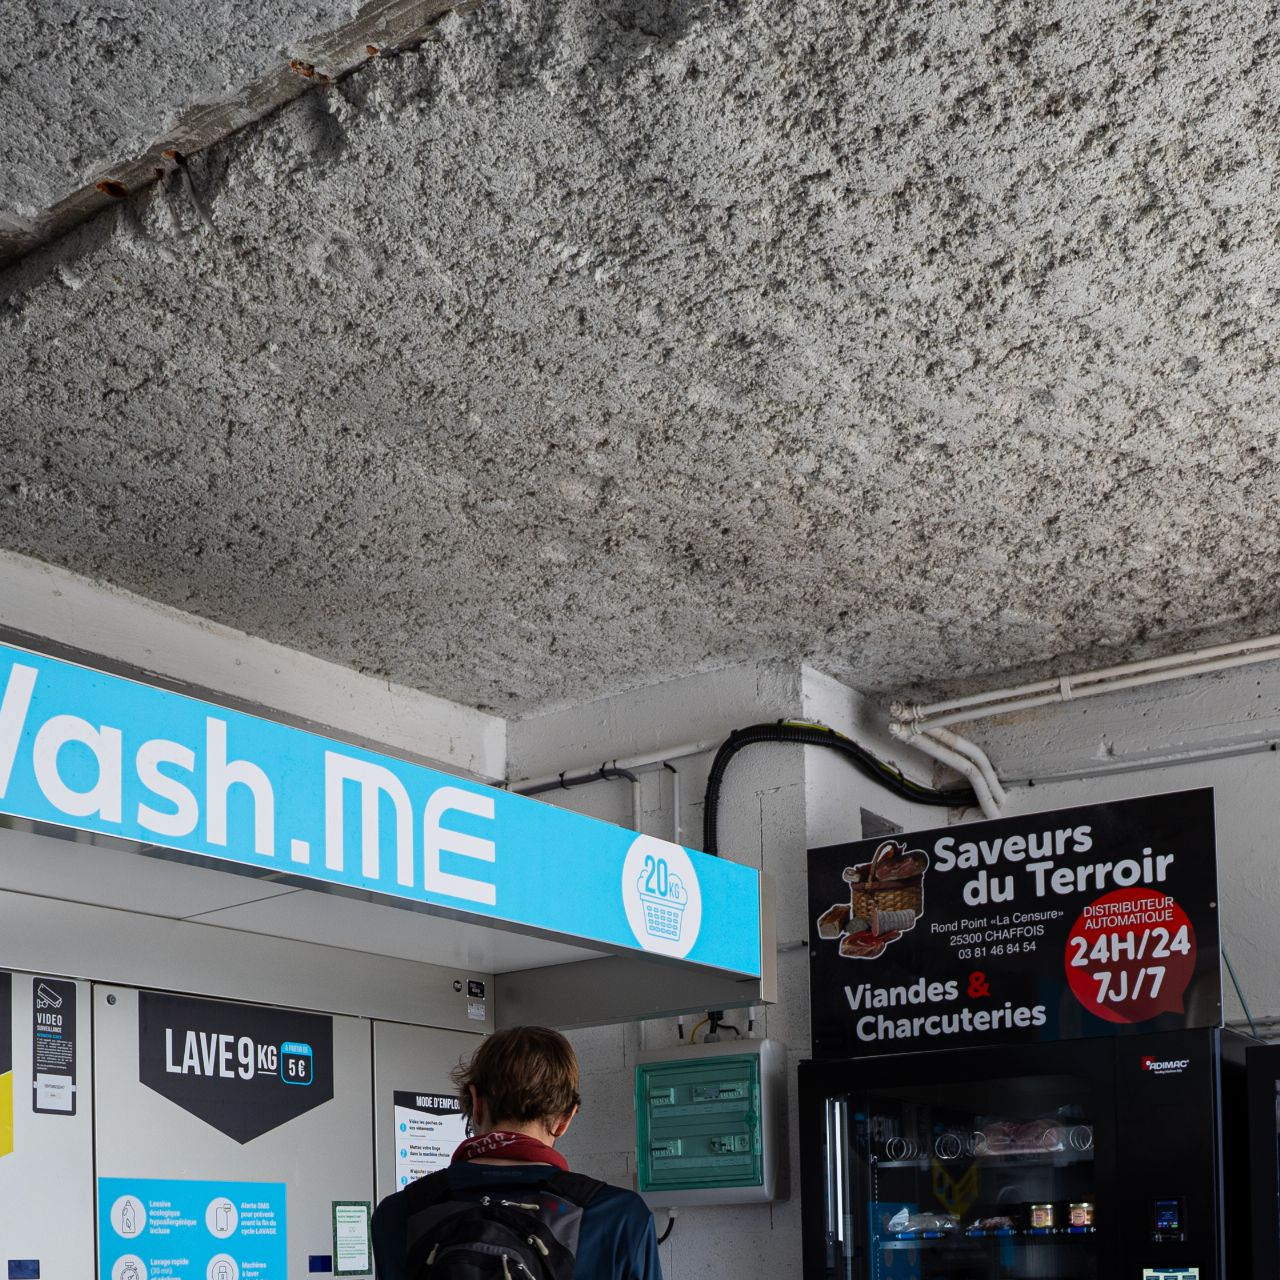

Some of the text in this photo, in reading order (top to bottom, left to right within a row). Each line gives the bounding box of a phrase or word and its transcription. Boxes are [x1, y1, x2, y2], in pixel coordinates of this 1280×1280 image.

[934, 824, 1093, 872] Saveurs
[644, 854, 668, 897] 20
[963, 847, 1174, 906] du Terroir
[931, 909, 1064, 933] Rond Point «La Censure»
[1083, 896, 1174, 918] DISTRIBUTEUR
[1084, 909, 1174, 931] AUTOMATIQUE
[950, 925, 1045, 946] 25300 CHAFFOIS
[958, 942, 1037, 960] 03 81 46 84 54
[1070, 925, 1191, 967] 24H/24
[844, 970, 991, 1011] Viandes &
[1093, 966, 1166, 1004] 7J/7
[37, 1012, 62, 1026] VIDEO
[856, 1002, 1047, 1042] Charcuteries
[166, 1028, 277, 1080] LAVE 9 KG
[288, 1059, 306, 1077] 5 €
[416, 1096, 432, 1107] MODE
